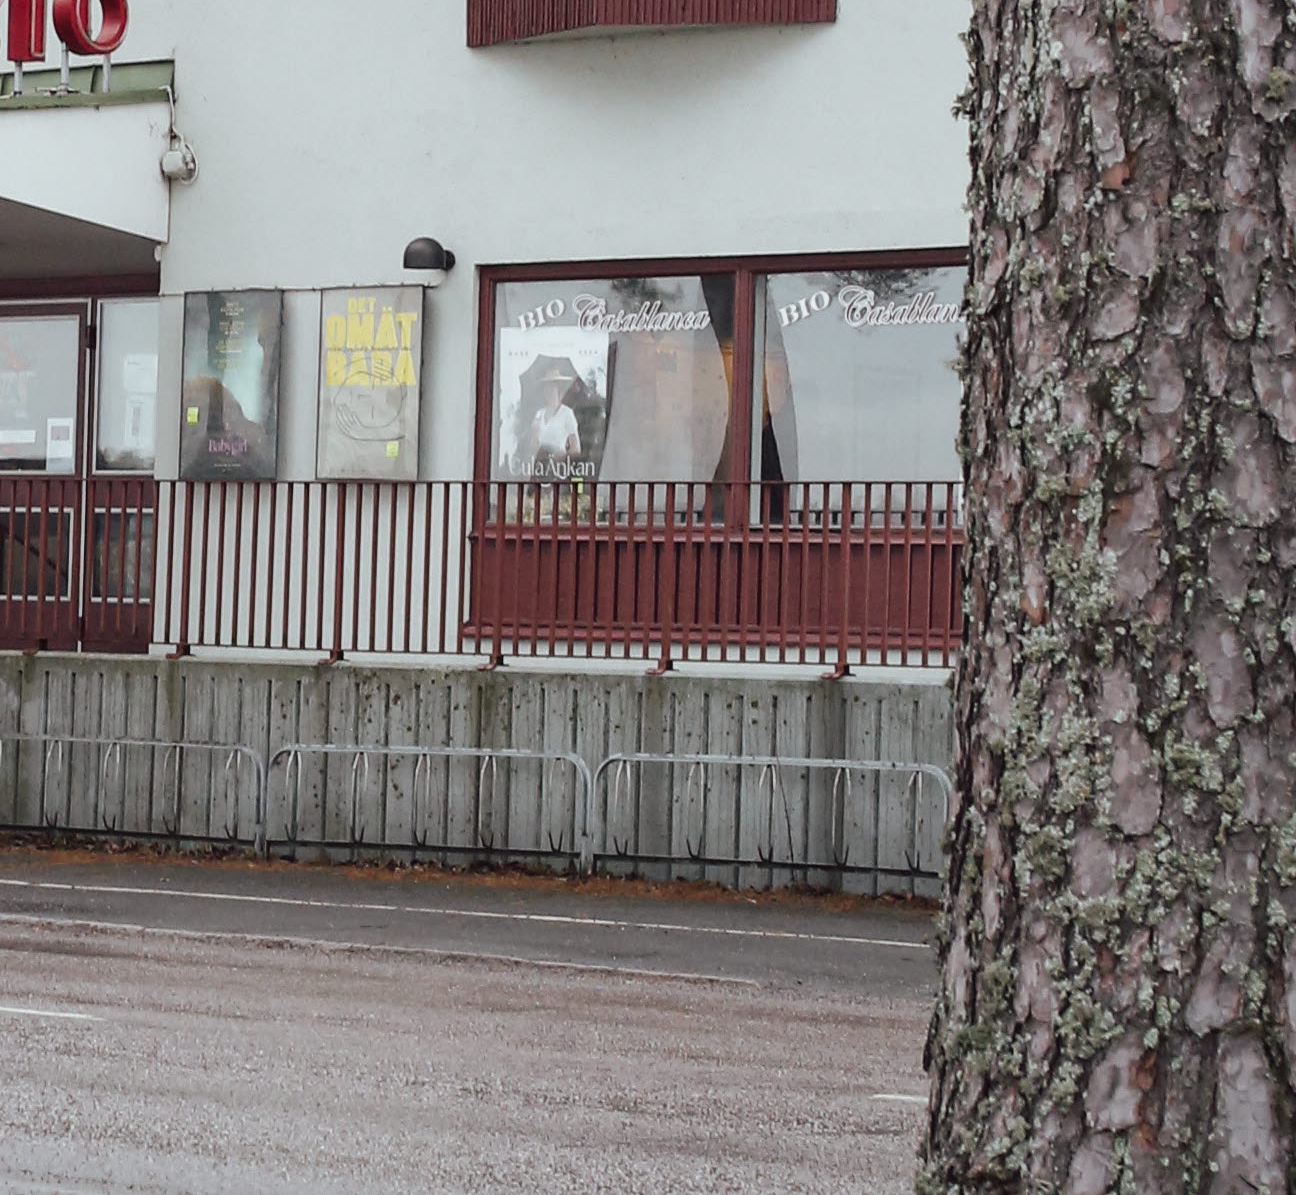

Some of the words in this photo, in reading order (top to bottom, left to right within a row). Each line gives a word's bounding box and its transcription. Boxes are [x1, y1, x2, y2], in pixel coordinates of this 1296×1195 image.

[347, 296, 376, 314] DET
[517, 298, 565, 333] BIO
[572, 293, 711, 333] Casablanca
[778, 290, 831, 327] BIO
[838, 284, 967, 327] Casablan
[326, 306, 418, 349] OMÄT
[326, 350, 417, 387] BARA
